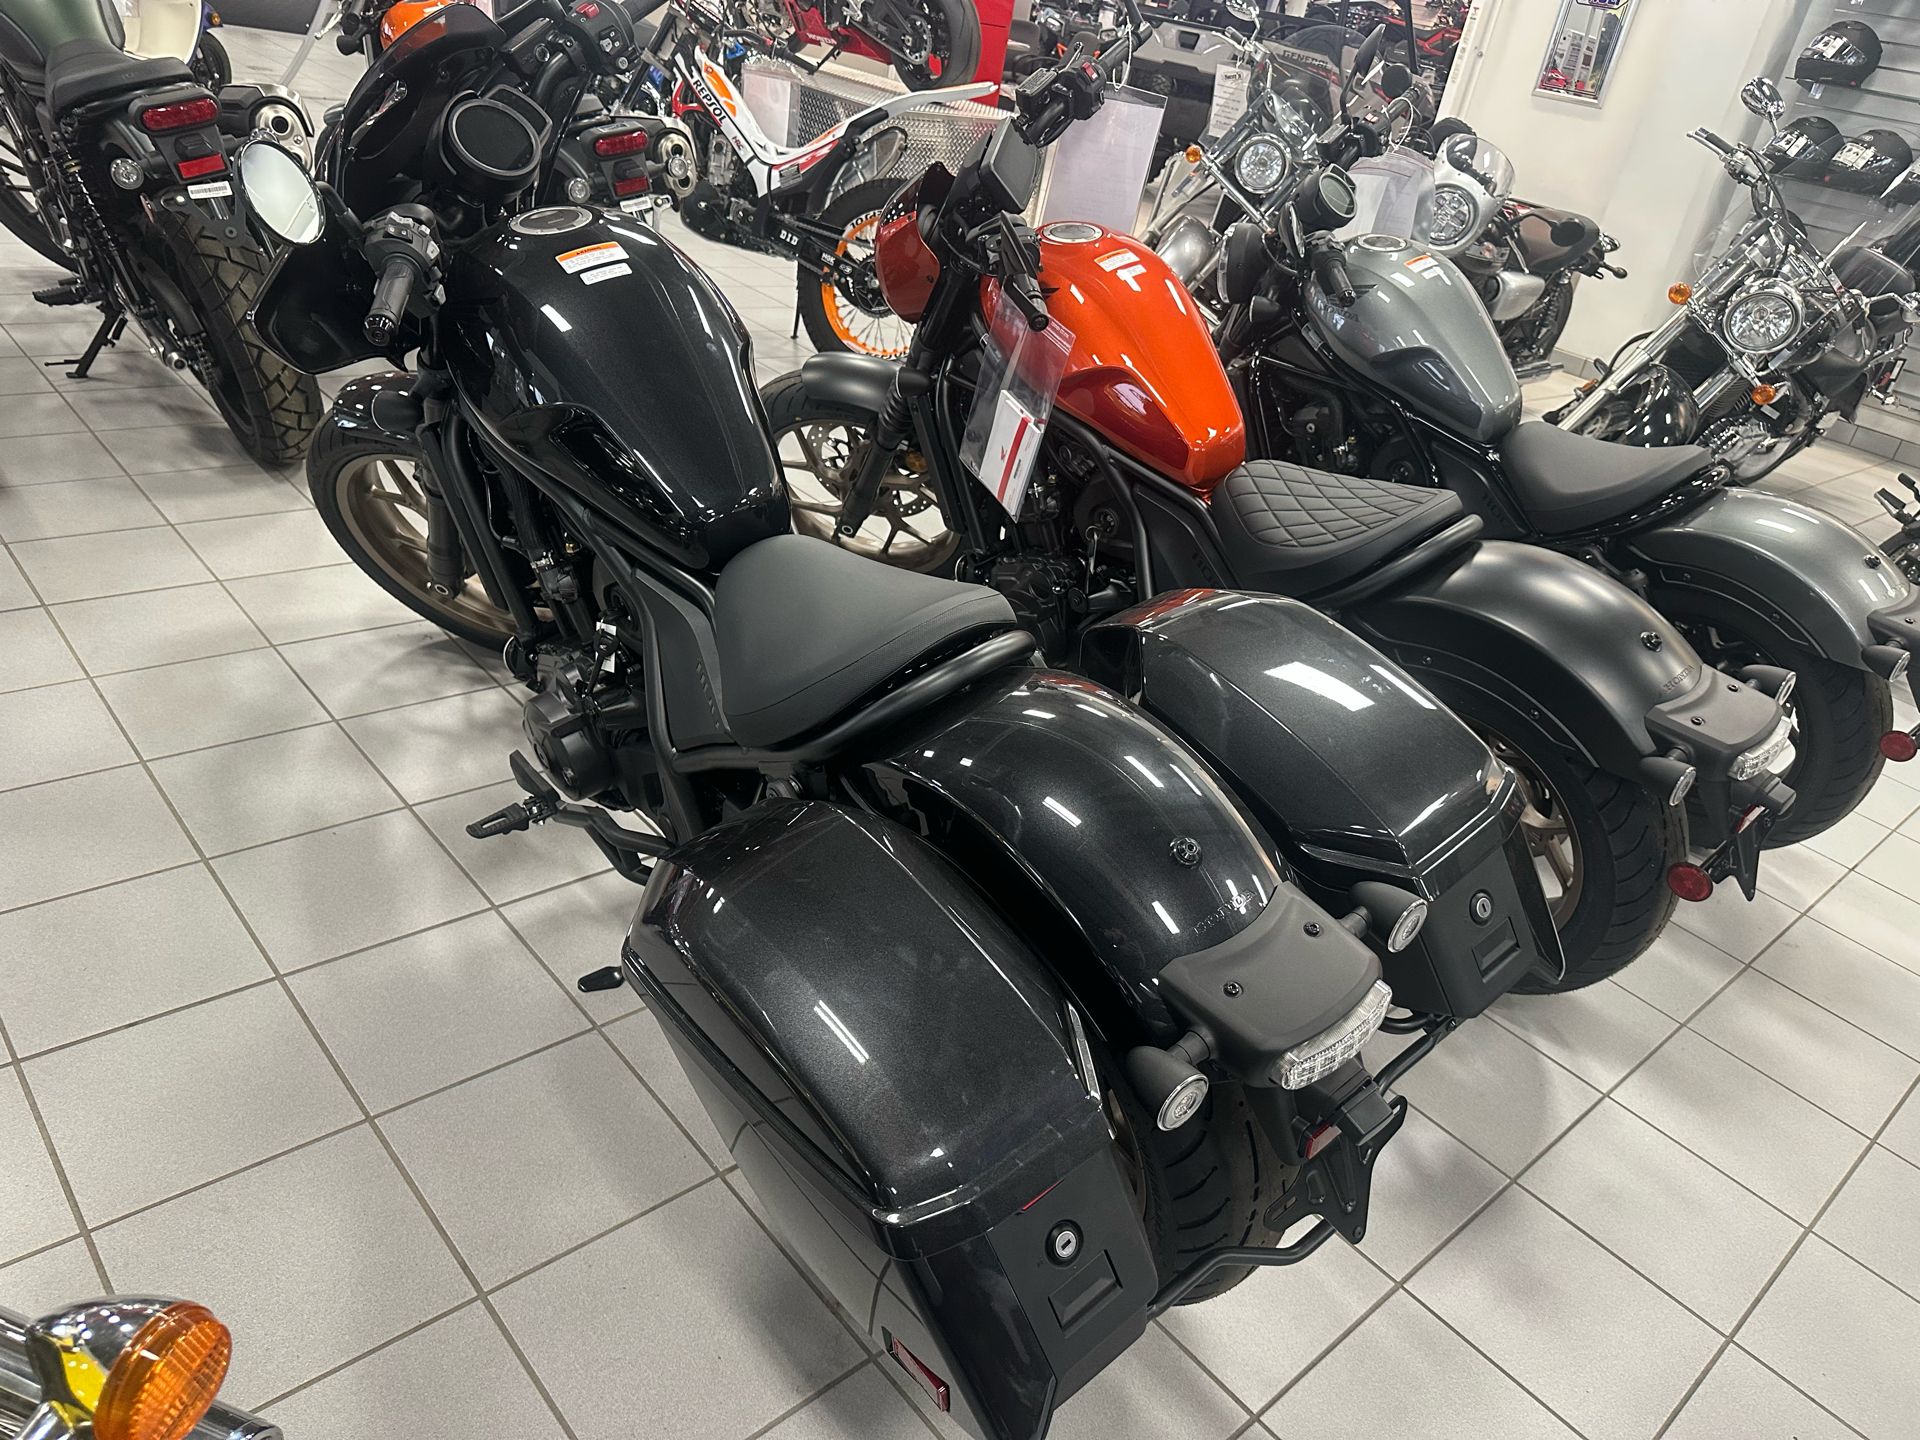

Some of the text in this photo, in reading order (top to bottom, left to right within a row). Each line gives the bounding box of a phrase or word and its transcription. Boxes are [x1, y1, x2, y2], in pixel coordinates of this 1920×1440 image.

[1282, 49, 1329, 68] GENERAL
[693, 78, 727, 124] REPSOL
[732, 136, 744, 150] HRC
[850, 210, 882, 229] EPSOL
[779, 230, 799, 246] DID
[821, 252, 836, 267] NGK
[1662, 664, 1695, 693] HONDA
